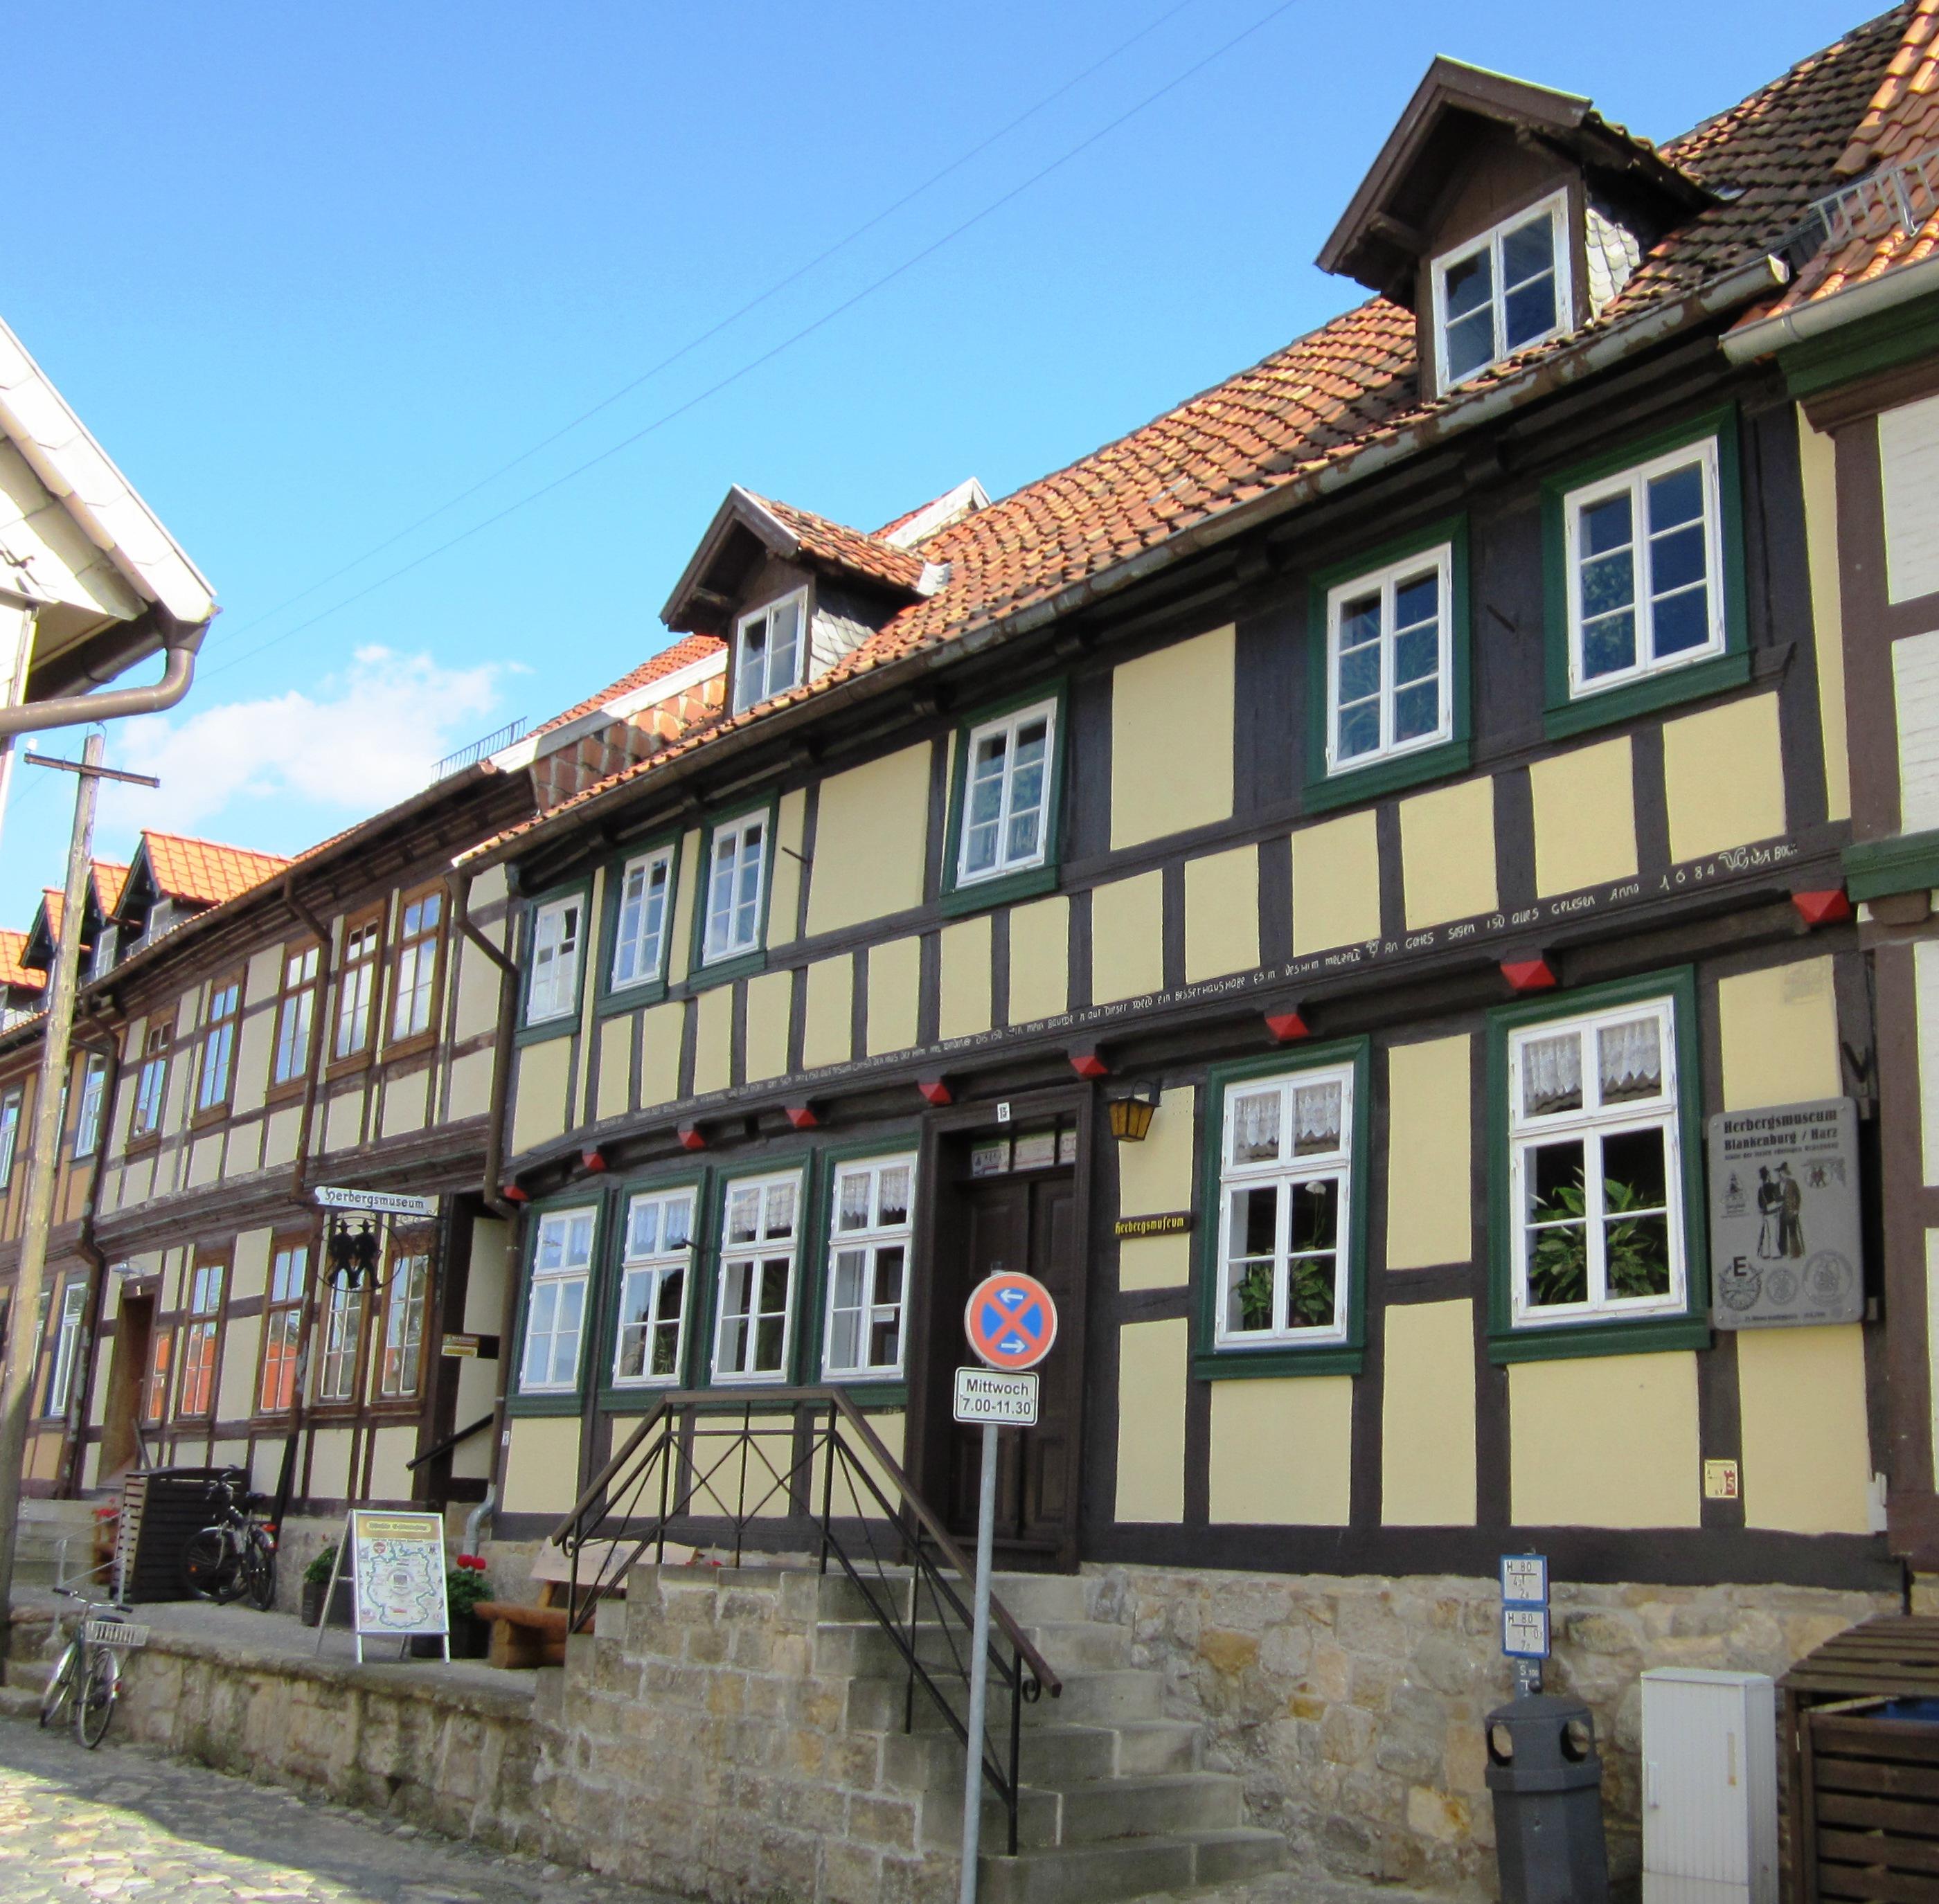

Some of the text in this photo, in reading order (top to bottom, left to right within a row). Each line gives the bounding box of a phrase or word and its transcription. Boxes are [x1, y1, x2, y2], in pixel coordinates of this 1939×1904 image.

[1723, 1109, 1838, 1134] Herbergsmuseum
[1724, 1131, 1797, 1151] Blankenburg
[1810, 1126, 1839, 1140] Harz
[325, 1187, 425, 1209] Herbergsmuseum
[1733, 1256, 1748, 1277] E
[966, 1378, 1030, 1396] Mittwoch
[962, 1397, 1031, 1416] 7.00-11.30
